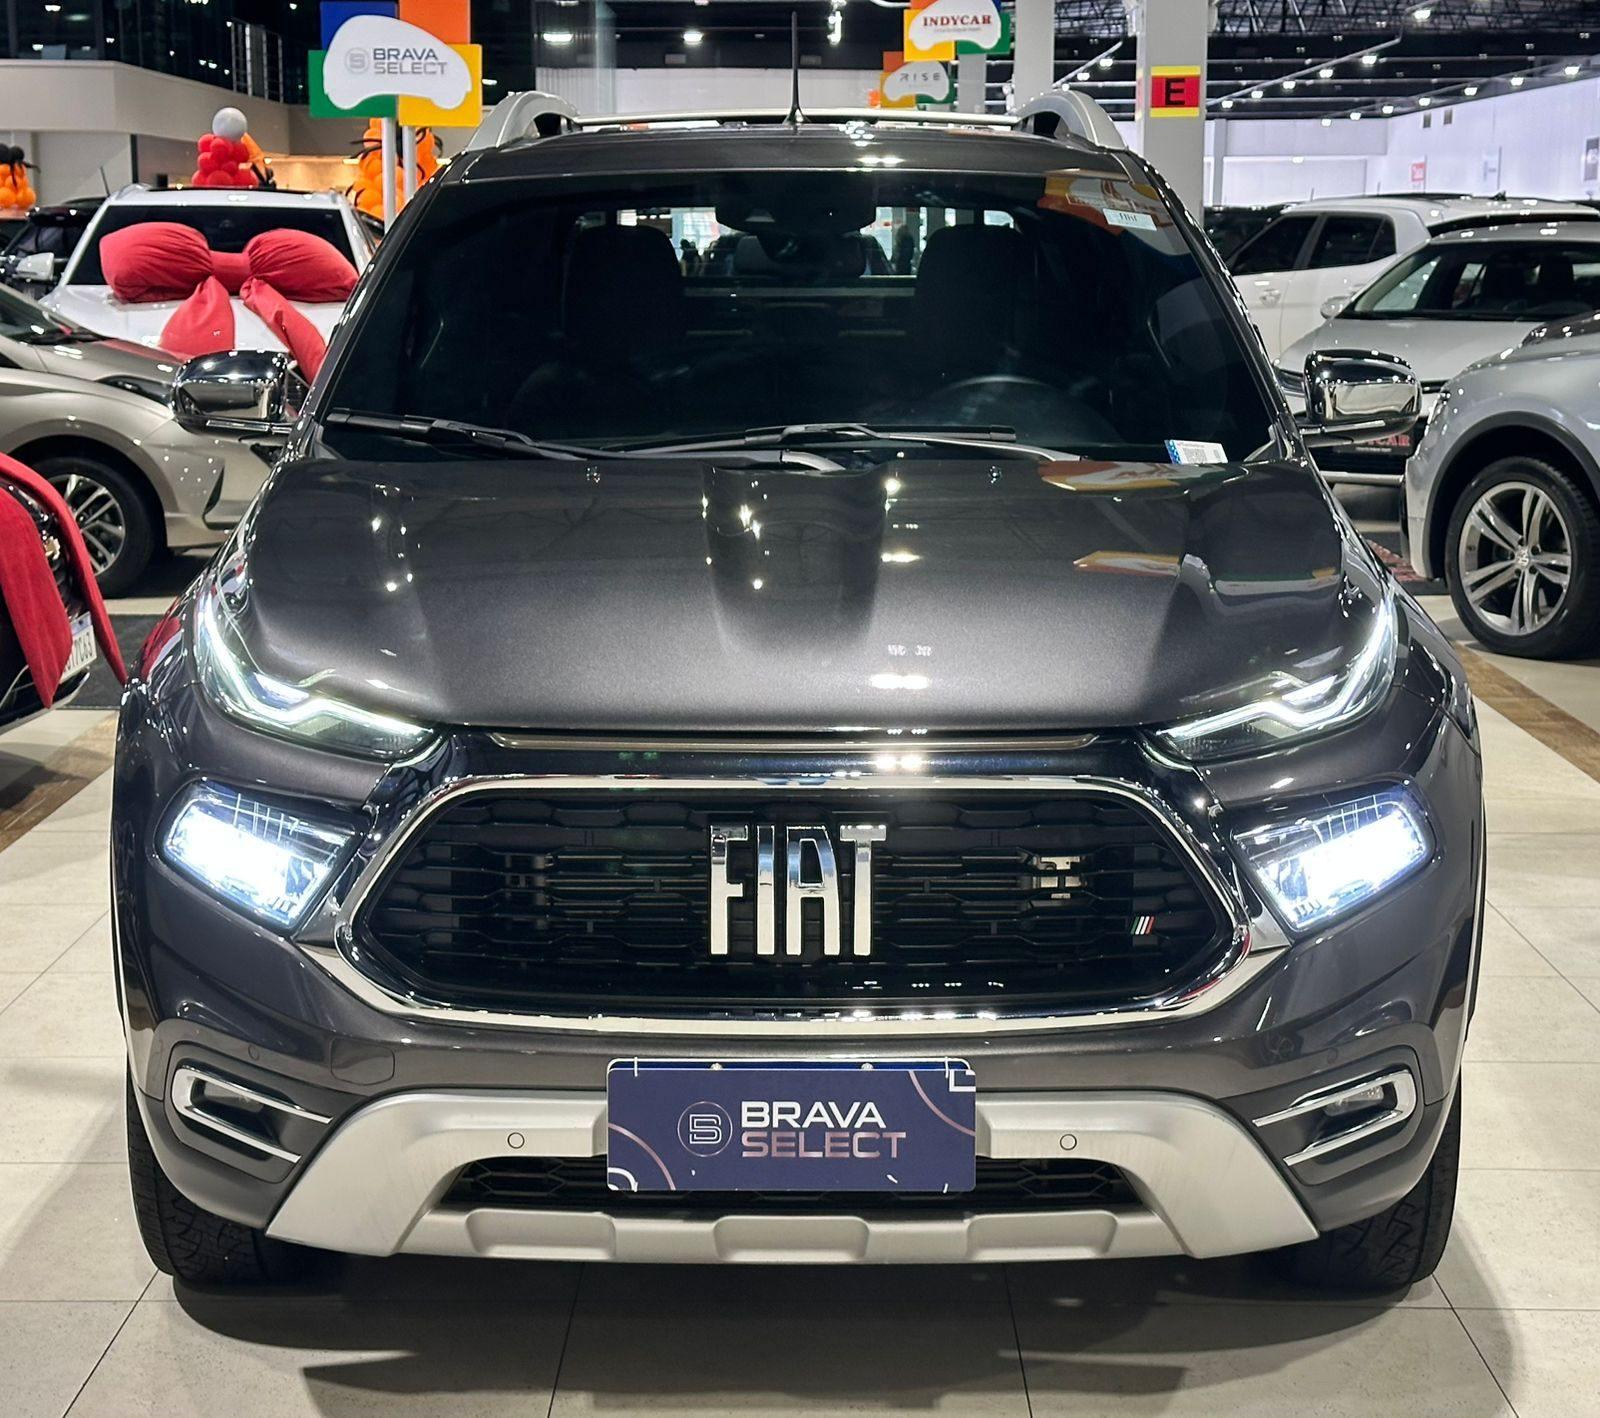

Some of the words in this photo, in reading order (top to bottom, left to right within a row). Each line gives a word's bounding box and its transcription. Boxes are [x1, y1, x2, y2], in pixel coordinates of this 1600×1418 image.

[923, 15, 992, 27] INDYCAR
[373, 48, 439, 61] BRAVA
[373, 62, 448, 75] SELECT
[1165, 78, 1186, 106] E
[710, 825, 887, 956] FIAT
[740, 1101, 887, 1129] BRAVA
[740, 1131, 907, 1159] SELECT
